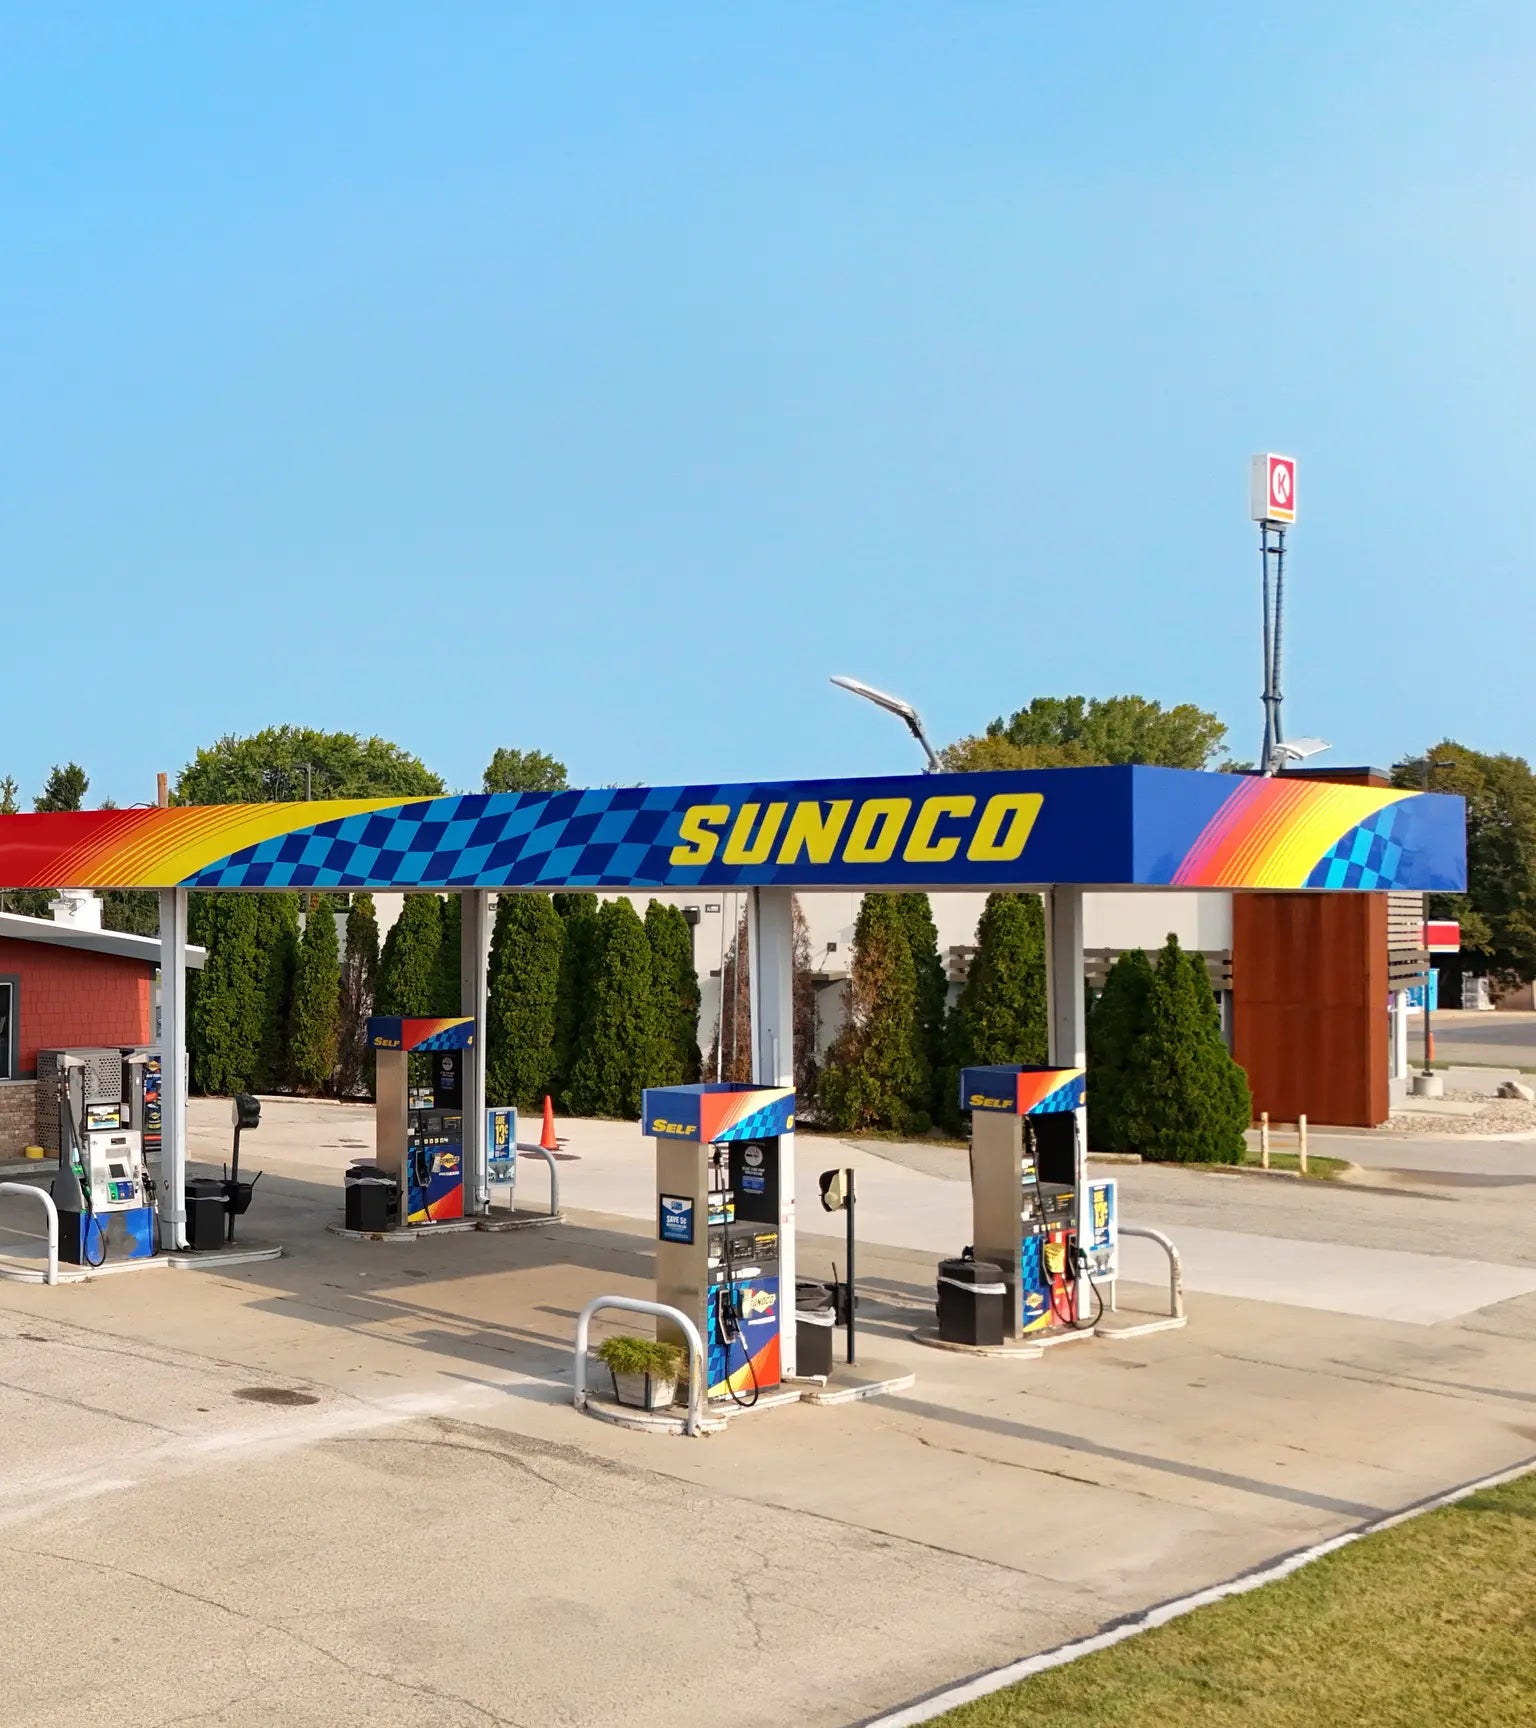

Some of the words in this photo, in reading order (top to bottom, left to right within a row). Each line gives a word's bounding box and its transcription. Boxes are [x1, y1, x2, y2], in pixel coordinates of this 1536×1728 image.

[669, 793, 1044, 865] SUNOCO
[373, 1036, 401, 1047] SELF
[467, 1035, 473, 1045] 4
[969, 1094, 1013, 1108] SELF
[652, 1119, 696, 1135] SELF
[786, 1115, 794, 1129] 6
